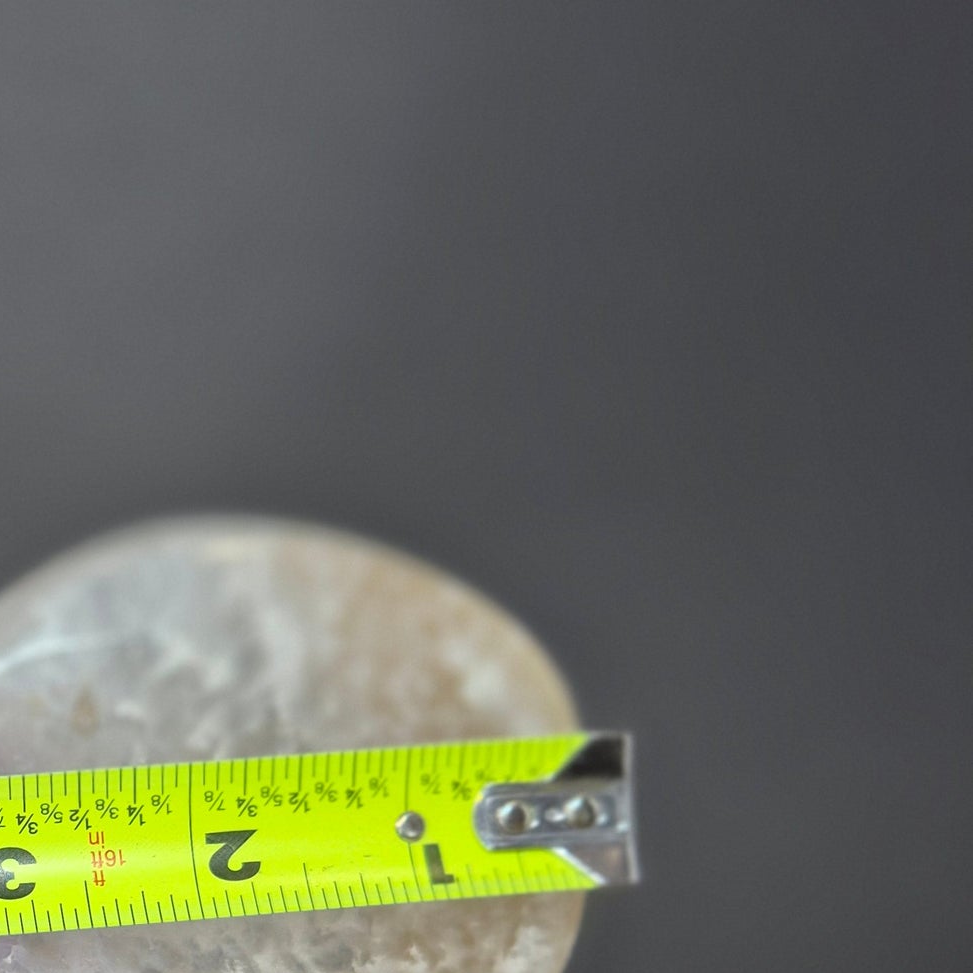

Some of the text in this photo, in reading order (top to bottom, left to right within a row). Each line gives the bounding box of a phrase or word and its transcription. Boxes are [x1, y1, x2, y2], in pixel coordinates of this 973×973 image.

[89, 831, 105, 848] in
[88, 848, 127, 869] 16ft
[204, 830, 261, 882] 2
[423, 843, 455, 884] 1
[89, 868, 106, 888] ft
